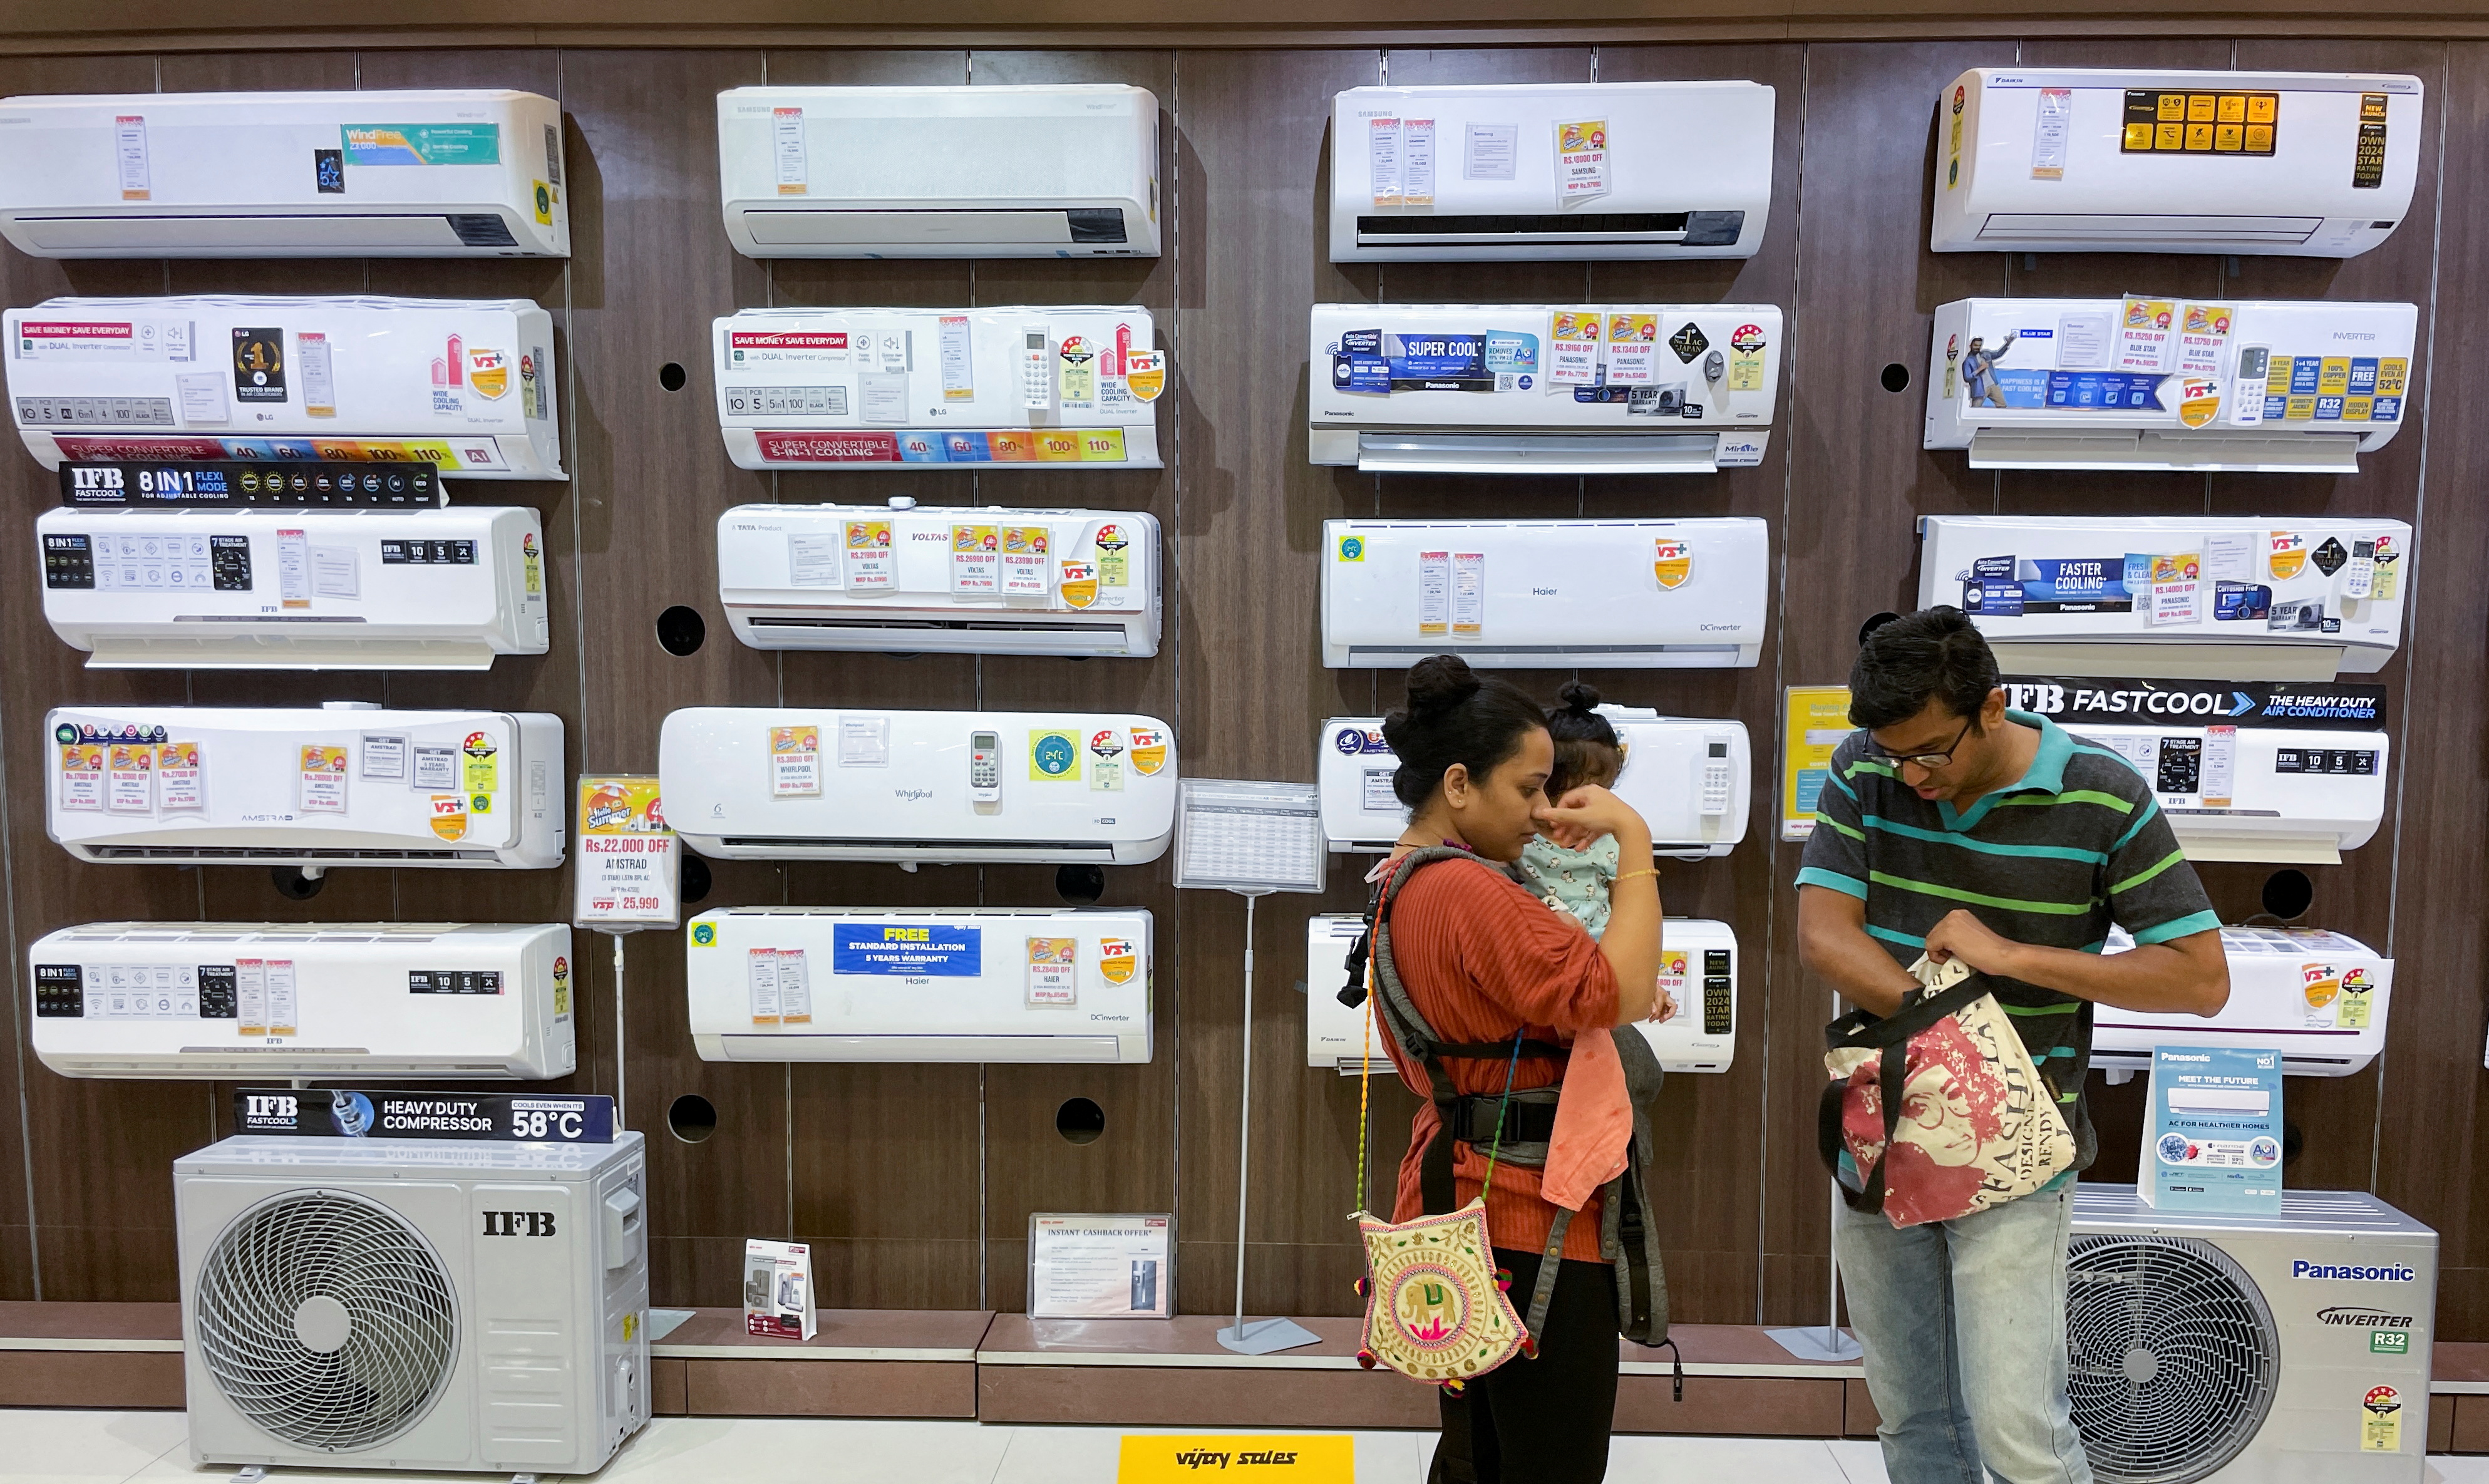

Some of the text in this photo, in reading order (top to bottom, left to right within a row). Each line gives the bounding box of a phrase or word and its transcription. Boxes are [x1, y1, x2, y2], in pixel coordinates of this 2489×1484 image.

[346, 129, 401, 141] WindFree
[2359, 136, 2385, 145] OWN
[2358, 146, 2383, 155] 2024
[2358, 155, 2382, 165] STAR
[1572, 167, 1596, 175] SAMSUNG
[24, 326, 130, 335] SAVE MONEY SAVE EVERYDAY
[734, 336, 845, 345] SAVE MONEY SAVE EVERYDAY
[2125, 331, 2152, 341] RS.15250
[2332, 332, 2376, 341] INVERTER
[1409, 342, 1445, 357] SUPER
[1555, 343, 1594, 353] RS.19160 OFF
[1612, 346, 1651, 354] RS.13410 OFF
[786, 353, 817, 361] Inverter
[2352, 372, 2374, 381] FREE
[1425, 381, 1460, 389] Panasonic
[2319, 398, 2340, 409] R32
[71, 445, 205, 455] SUPER CONVERTIBLE
[768, 440, 889, 450] SUPER CONVERTIBLE
[772, 448, 811, 456] 5-IN-1
[71, 468, 124, 488] IFB
[139, 471, 153, 490] 8
[157, 471, 181, 491] IN
[196, 472, 223, 482] FLEXI
[197, 482, 228, 492] MODE
[912, 533, 948, 541] VOLTAS
[2059, 563, 2101, 575] FASTER
[1532, 587, 1557, 596] Haier
[2155, 584, 2196, 594] RS.14000 OFF
[2161, 596, 2190, 604] PANASONIC
[2001, 683, 2232, 716] FB FASTCOOL
[2269, 695, 2376, 708] THE HEAVY DUTY
[1811, 703, 1840, 711] Buying
[2262, 705, 2376, 719] AIR CONDITIONER
[2308, 755, 2321, 766] 10
[895, 789, 932, 801] Whirlpool
[586, 839, 669, 854] Rs.22,000 OFF
[606, 858, 647, 870] AMSTRAD
[623, 897, 659, 911] 25,990
[884, 928, 930, 942] FREE
[848, 942, 966, 952] STANDARD INSTALLATION
[901, 955, 949, 963] WARRANTY
[905, 976, 930, 985] Haier
[1706, 989, 1730, 997] OWN
[1706, 997, 1730, 1006] 2024
[2161, 1052, 2211, 1063] Panasonic
[2223, 1077, 2259, 1085] FUTURE
[247, 1096, 297, 1116] IFB
[384, 1100, 478, 1116] HEAVY DUTY
[247, 1117, 292, 1125] FASTCOOL
[383, 1116, 492, 1131] COMPRESSOR
[512, 1111, 583, 1138] 58°C
[482, 1211, 556, 1237] IFB
[2293, 1260, 2414, 1281] Panasonic
[2324, 1313, 2413, 1328] INVERTER
[2374, 1332, 2405, 1346] R32
[1175, 1448, 1298, 1470] vijay sales
